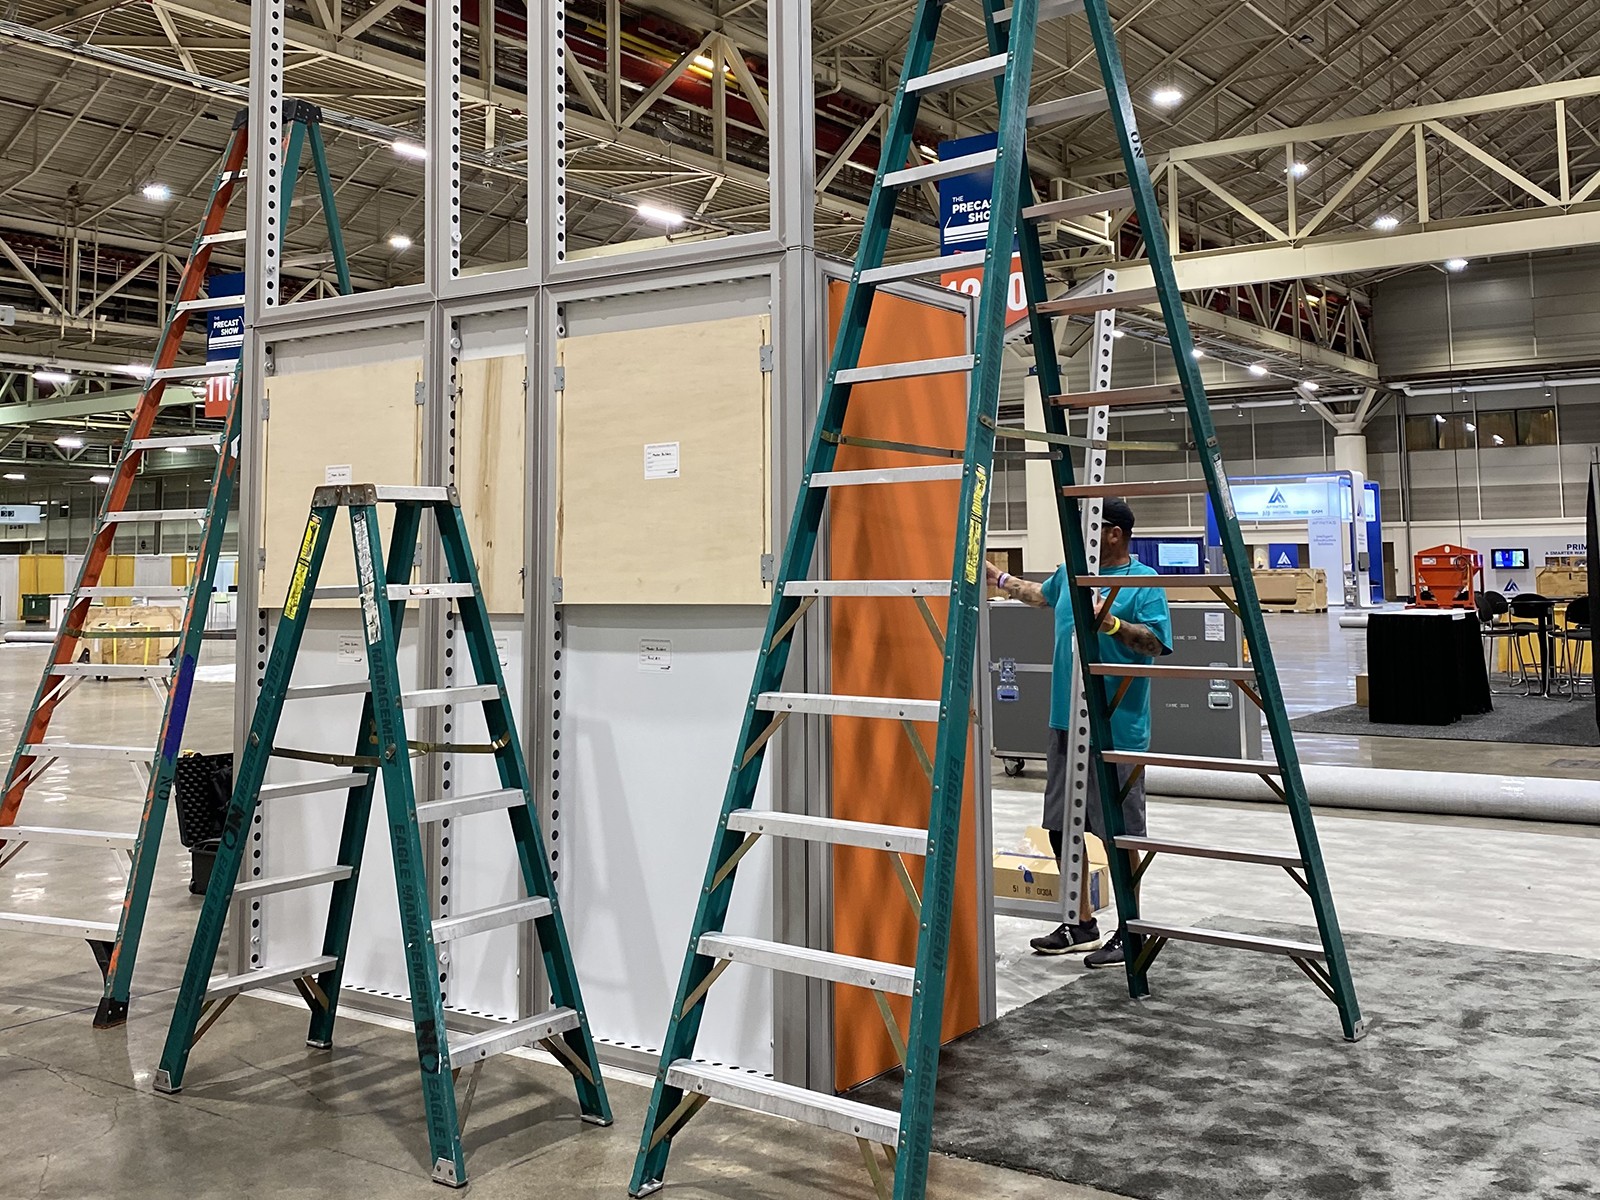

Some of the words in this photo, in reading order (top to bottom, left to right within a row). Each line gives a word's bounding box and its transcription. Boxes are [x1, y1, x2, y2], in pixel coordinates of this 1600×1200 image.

[952, 199, 993, 214] PRECA
[968, 211, 991, 223] SHO
[213, 319, 239, 329] PRECAST
[221, 327, 239, 336] SHOW
[980, 330, 999, 445] MANAGEMNT
[957, 584, 977, 696] ANAGEMENT
[260, 645, 284, 697] EAGLE
[372, 648, 397, 767] MANAGEMET
[232, 697, 275, 808] MANGEMENT
[944, 755, 960, 824] EAGLE
[222, 803, 247, 850] NO
[394, 824, 411, 879] EAGLE
[209, 853, 228, 906] EAGLE
[931, 823, 957, 976] MANAGEMENT
[402, 884, 430, 1018] MANAGEMENT
[416, 1019, 439, 1074] NO
[427, 1077, 446, 1138] EAGLE
[918, 1044, 934, 1116] EAGLE
